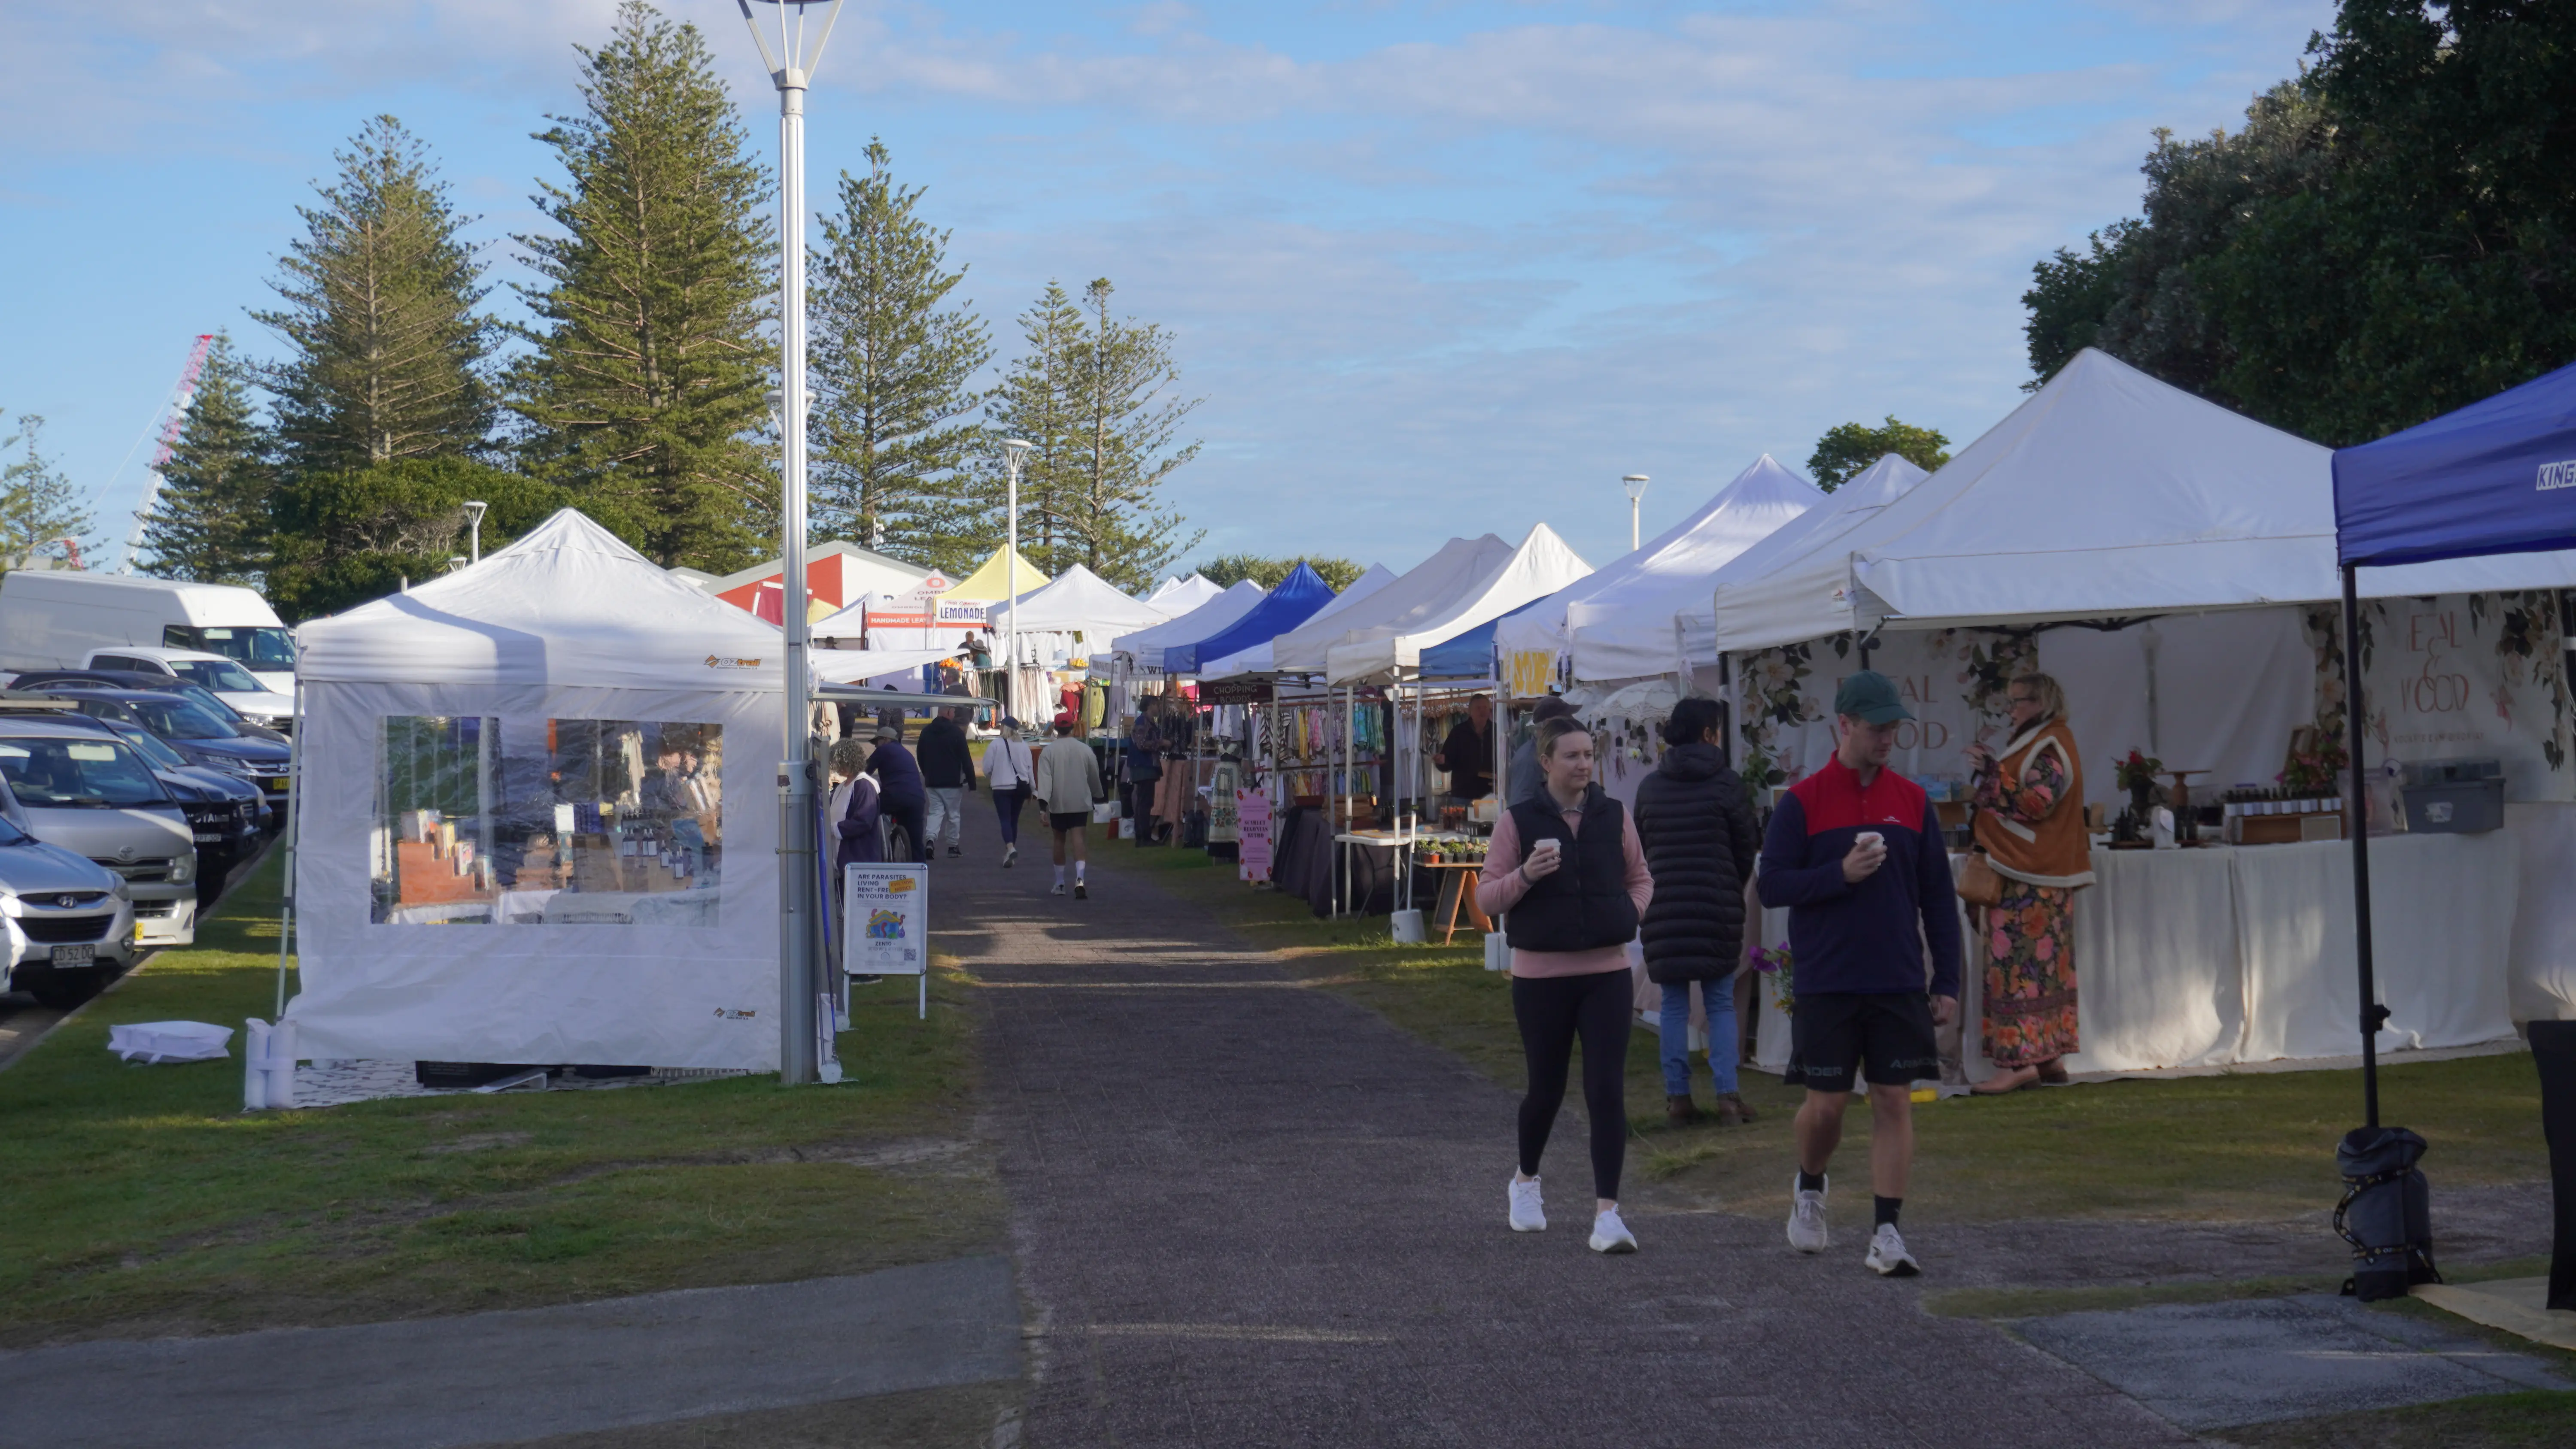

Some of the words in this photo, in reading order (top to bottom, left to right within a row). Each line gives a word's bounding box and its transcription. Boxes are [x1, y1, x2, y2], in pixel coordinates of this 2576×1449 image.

[2537, 461, 2576, 490] KING
[941, 607, 984, 619] LEMONADE
[721, 658, 761, 667] OZtrail
[1214, 685, 1258, 694] CHOPPING
[1220, 695, 1252, 704] BOARDS
[53, 948, 65, 961] CD
[68, 947, 78, 961] 52
